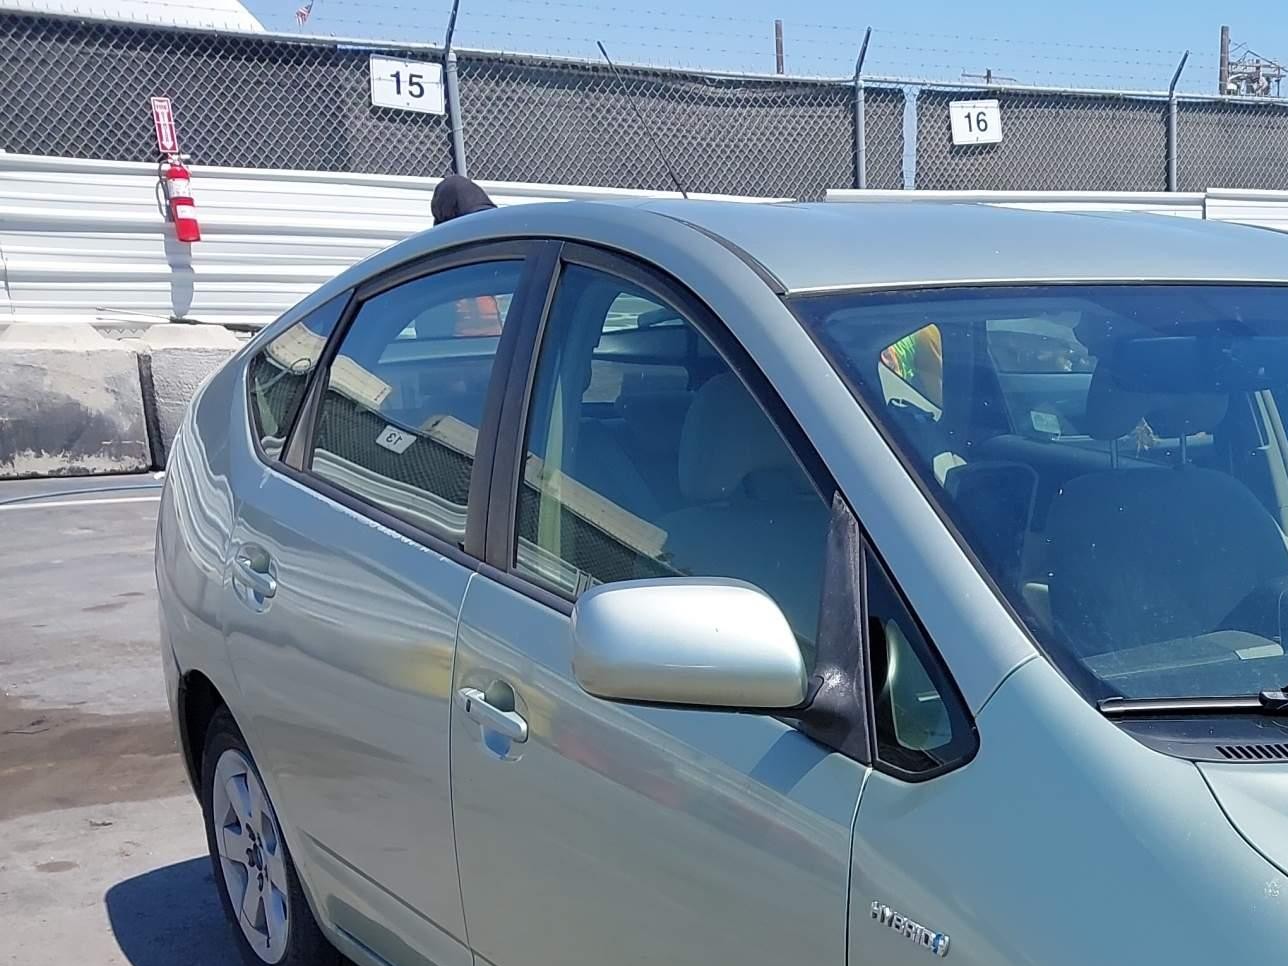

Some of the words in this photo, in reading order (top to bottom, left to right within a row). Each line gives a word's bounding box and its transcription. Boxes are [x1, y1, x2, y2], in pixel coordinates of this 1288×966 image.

[389, 70, 425, 99] 15
[964, 111, 988, 133] 16
[870, 899, 933, 951] HYBRID
